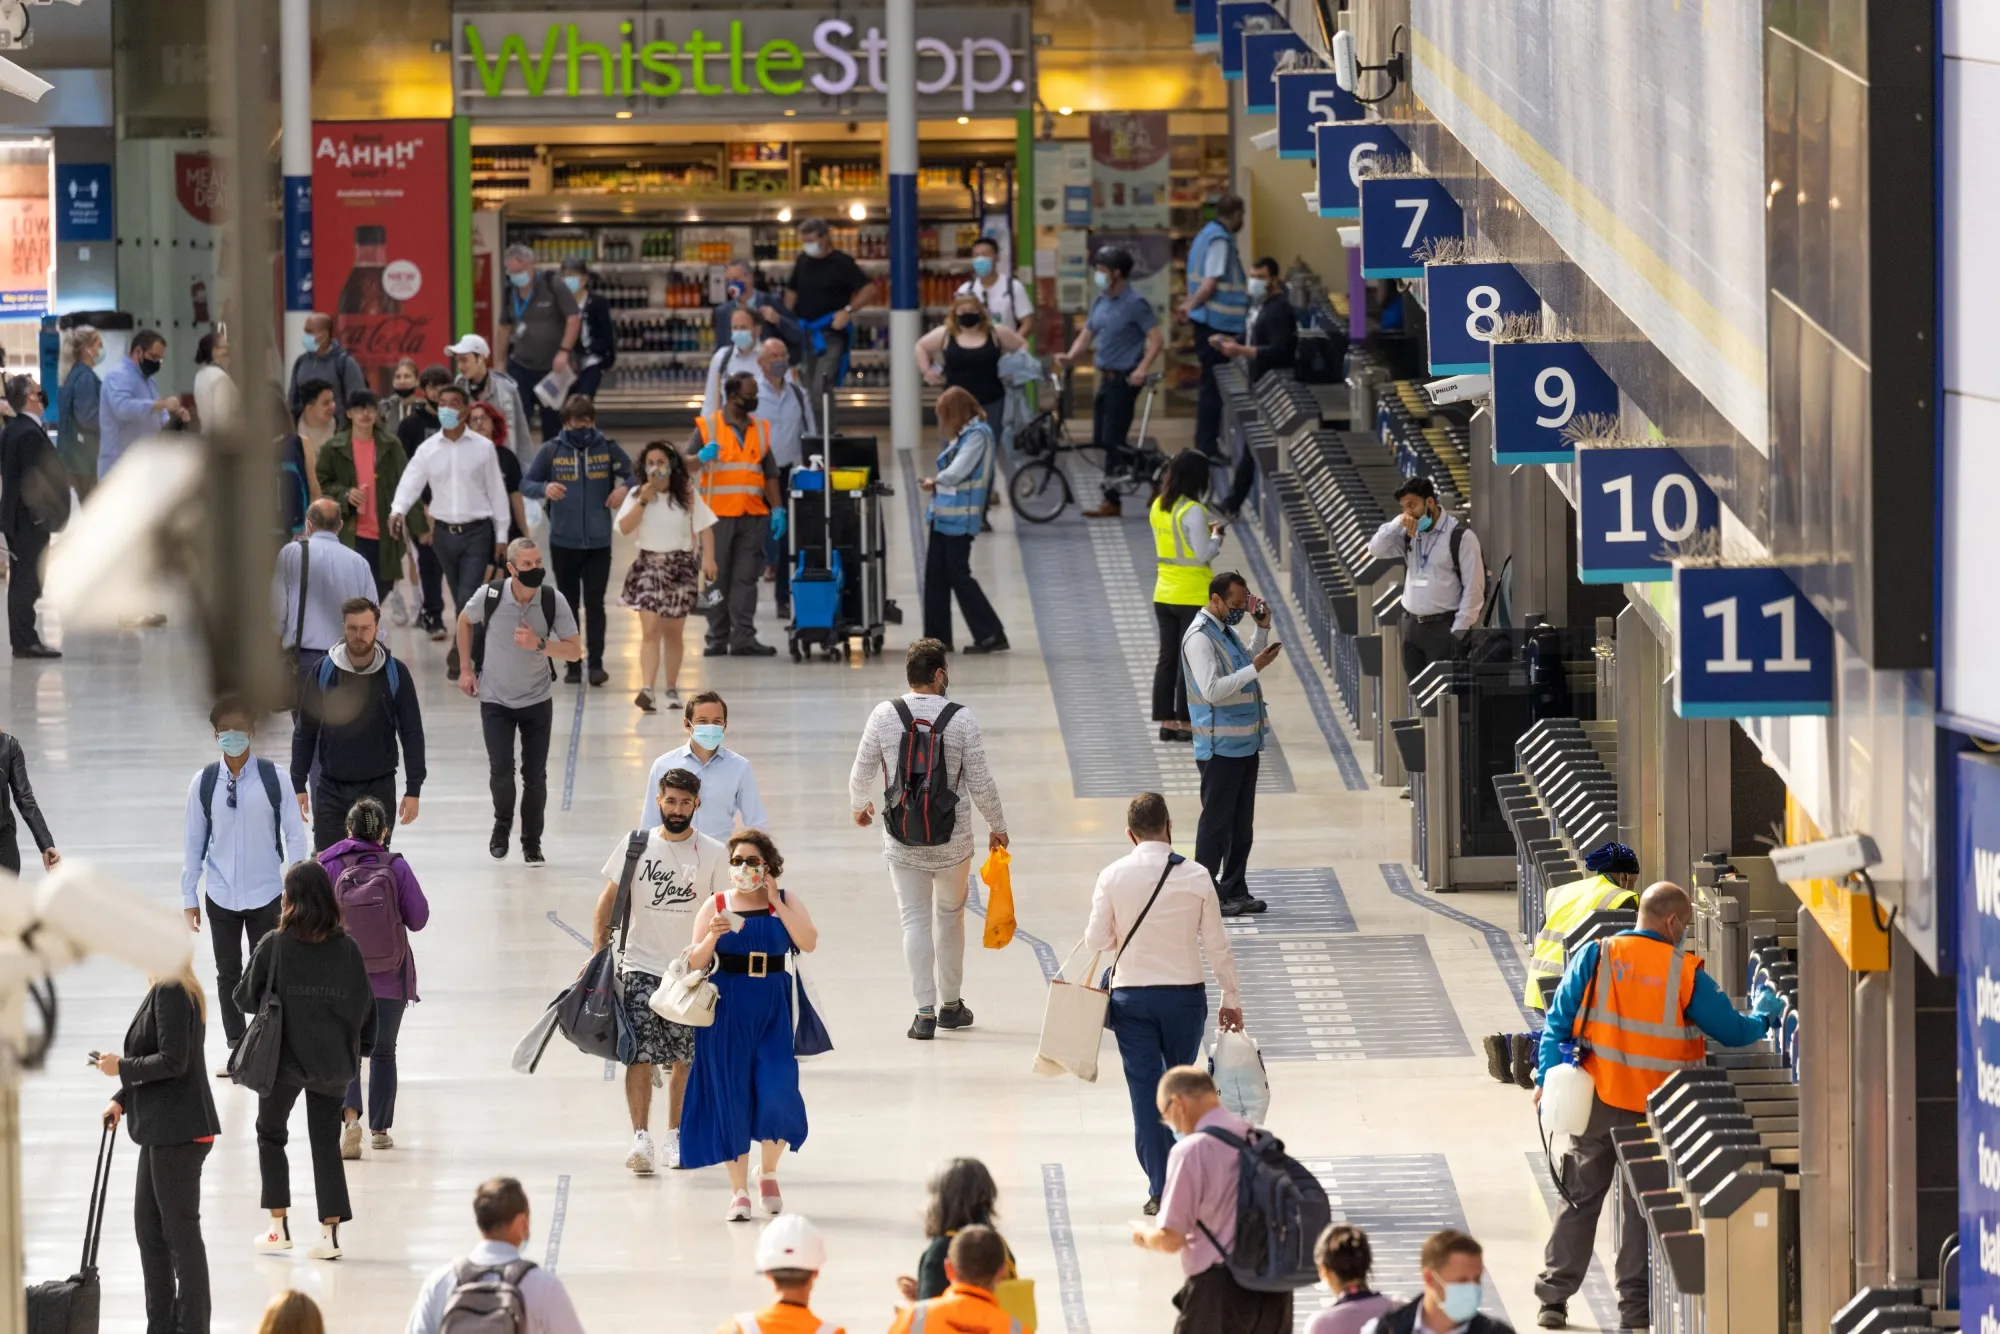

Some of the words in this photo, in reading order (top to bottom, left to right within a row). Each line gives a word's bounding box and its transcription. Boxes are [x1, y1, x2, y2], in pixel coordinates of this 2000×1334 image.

[1307, 90, 1337, 133] 5
[1348, 142, 1379, 189] 6
[1395, 198, 1429, 248] 7
[1465, 285, 1503, 342] 8
[1435, 384, 1459, 395] PHILIPS
[1534, 366, 1576, 429] 9
[1601, 472, 1699, 542] 10
[1702, 595, 1812, 674] 11
[639, 859, 676, 882] New
[652, 881, 697, 905] York
[286, 984, 349, 999] ESSENTIALS
